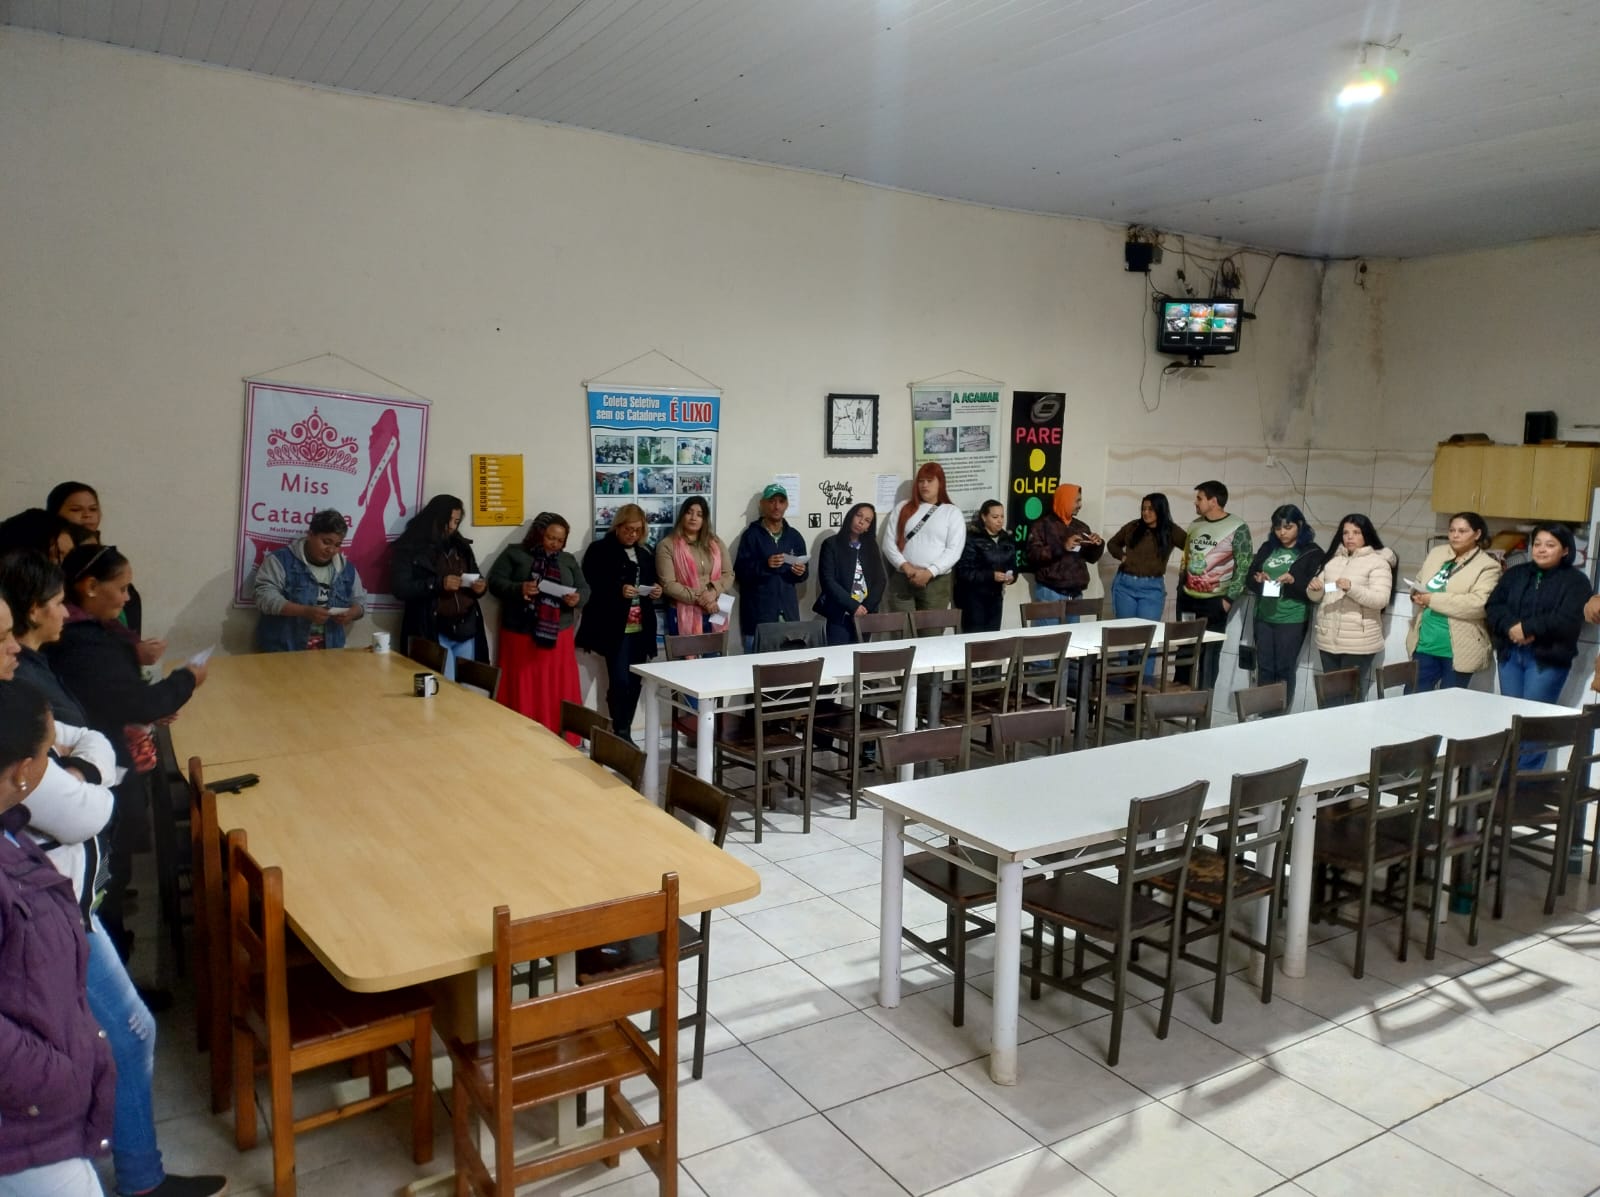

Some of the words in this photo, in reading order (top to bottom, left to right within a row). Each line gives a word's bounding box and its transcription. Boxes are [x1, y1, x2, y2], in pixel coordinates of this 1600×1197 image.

[603, 394, 628, 407] Coleta
[630, 396, 660, 409] Seletiva
[670, 397, 679, 422] É
[682, 401, 712, 423] LIXO
[596, 409, 613, 420] sem
[615, 410, 625, 420] os
[627, 409, 666, 422] Catadores
[1016, 427, 1062, 445] PARE
[280, 473, 329, 495] Miss
[1014, 477, 1058, 494] OLHE
[251, 502, 353, 528] Catada
